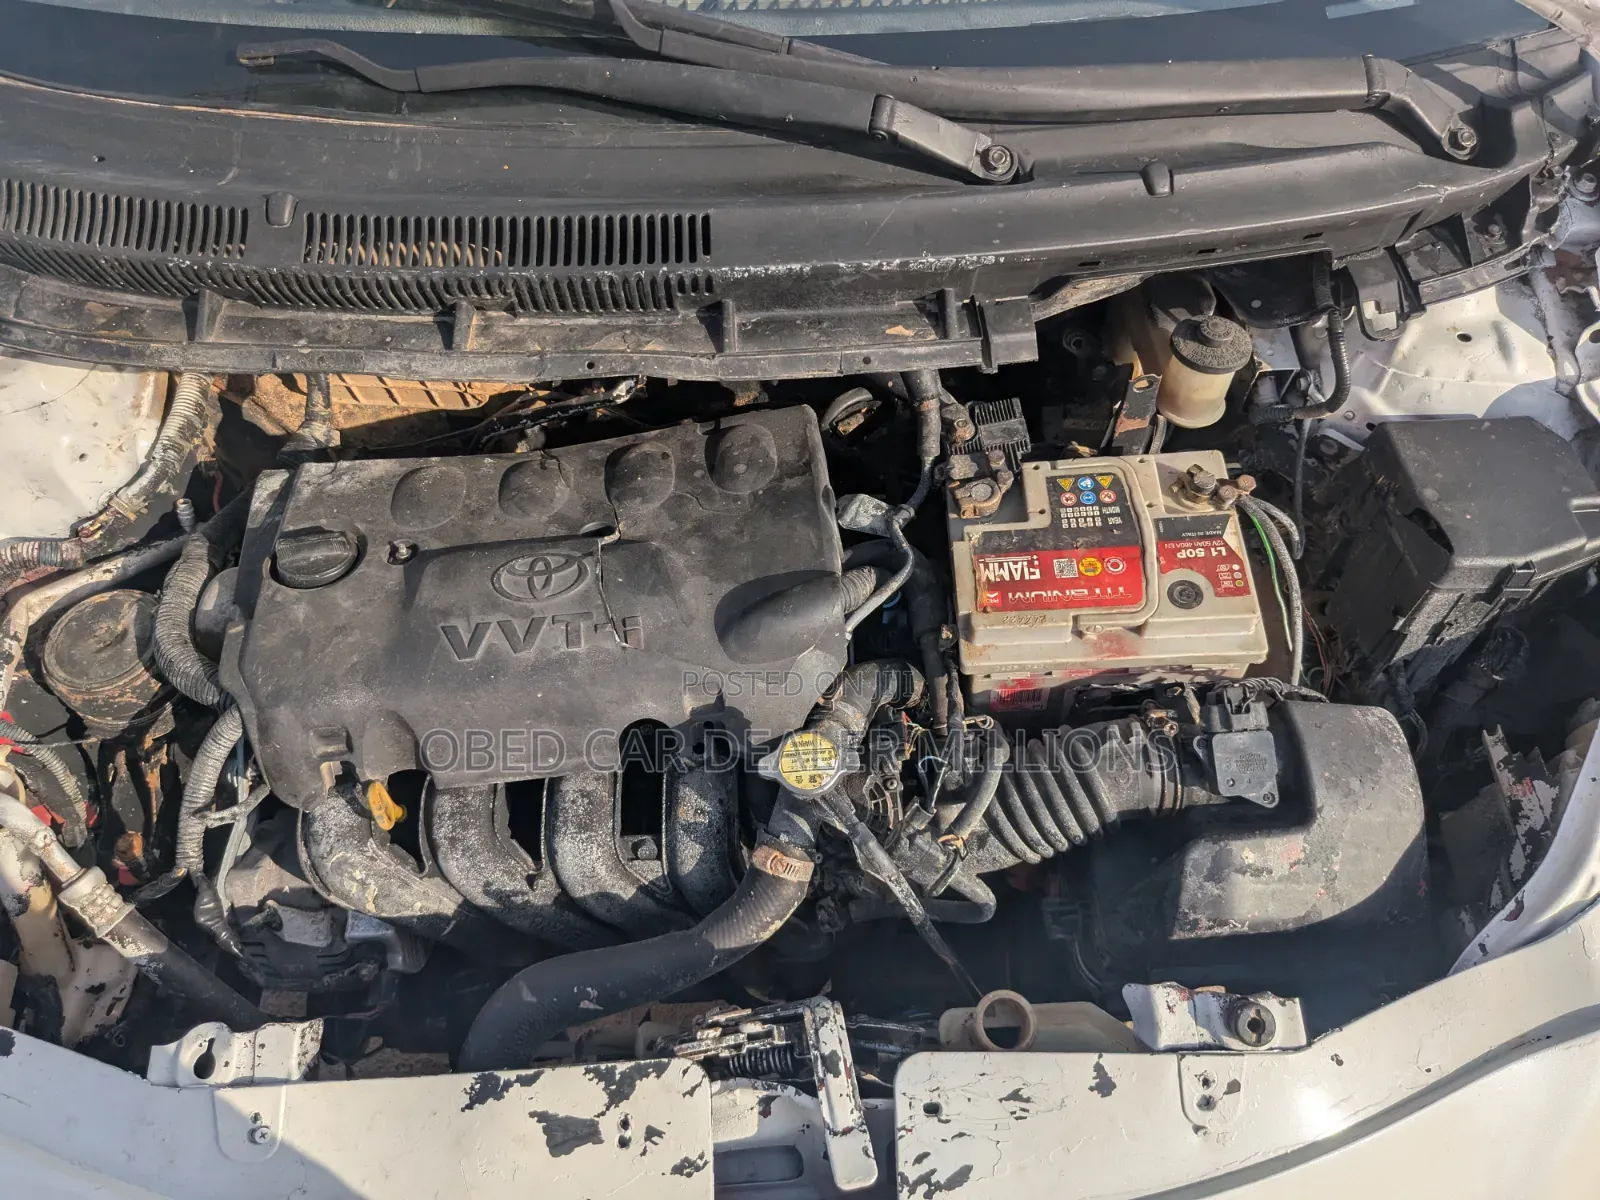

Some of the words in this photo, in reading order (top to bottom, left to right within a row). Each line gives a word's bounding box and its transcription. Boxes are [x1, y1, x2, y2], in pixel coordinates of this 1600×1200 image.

[1107, 517, 1123, 525] YEAR
[1176, 547, 1205, 559] 50P
[1211, 546, 1227, 556] L1
[979, 560, 1041, 582] FIAMM
[1008, 586, 1132, 604] TITANIUM
[790, 740, 815, 748] WARNNG
